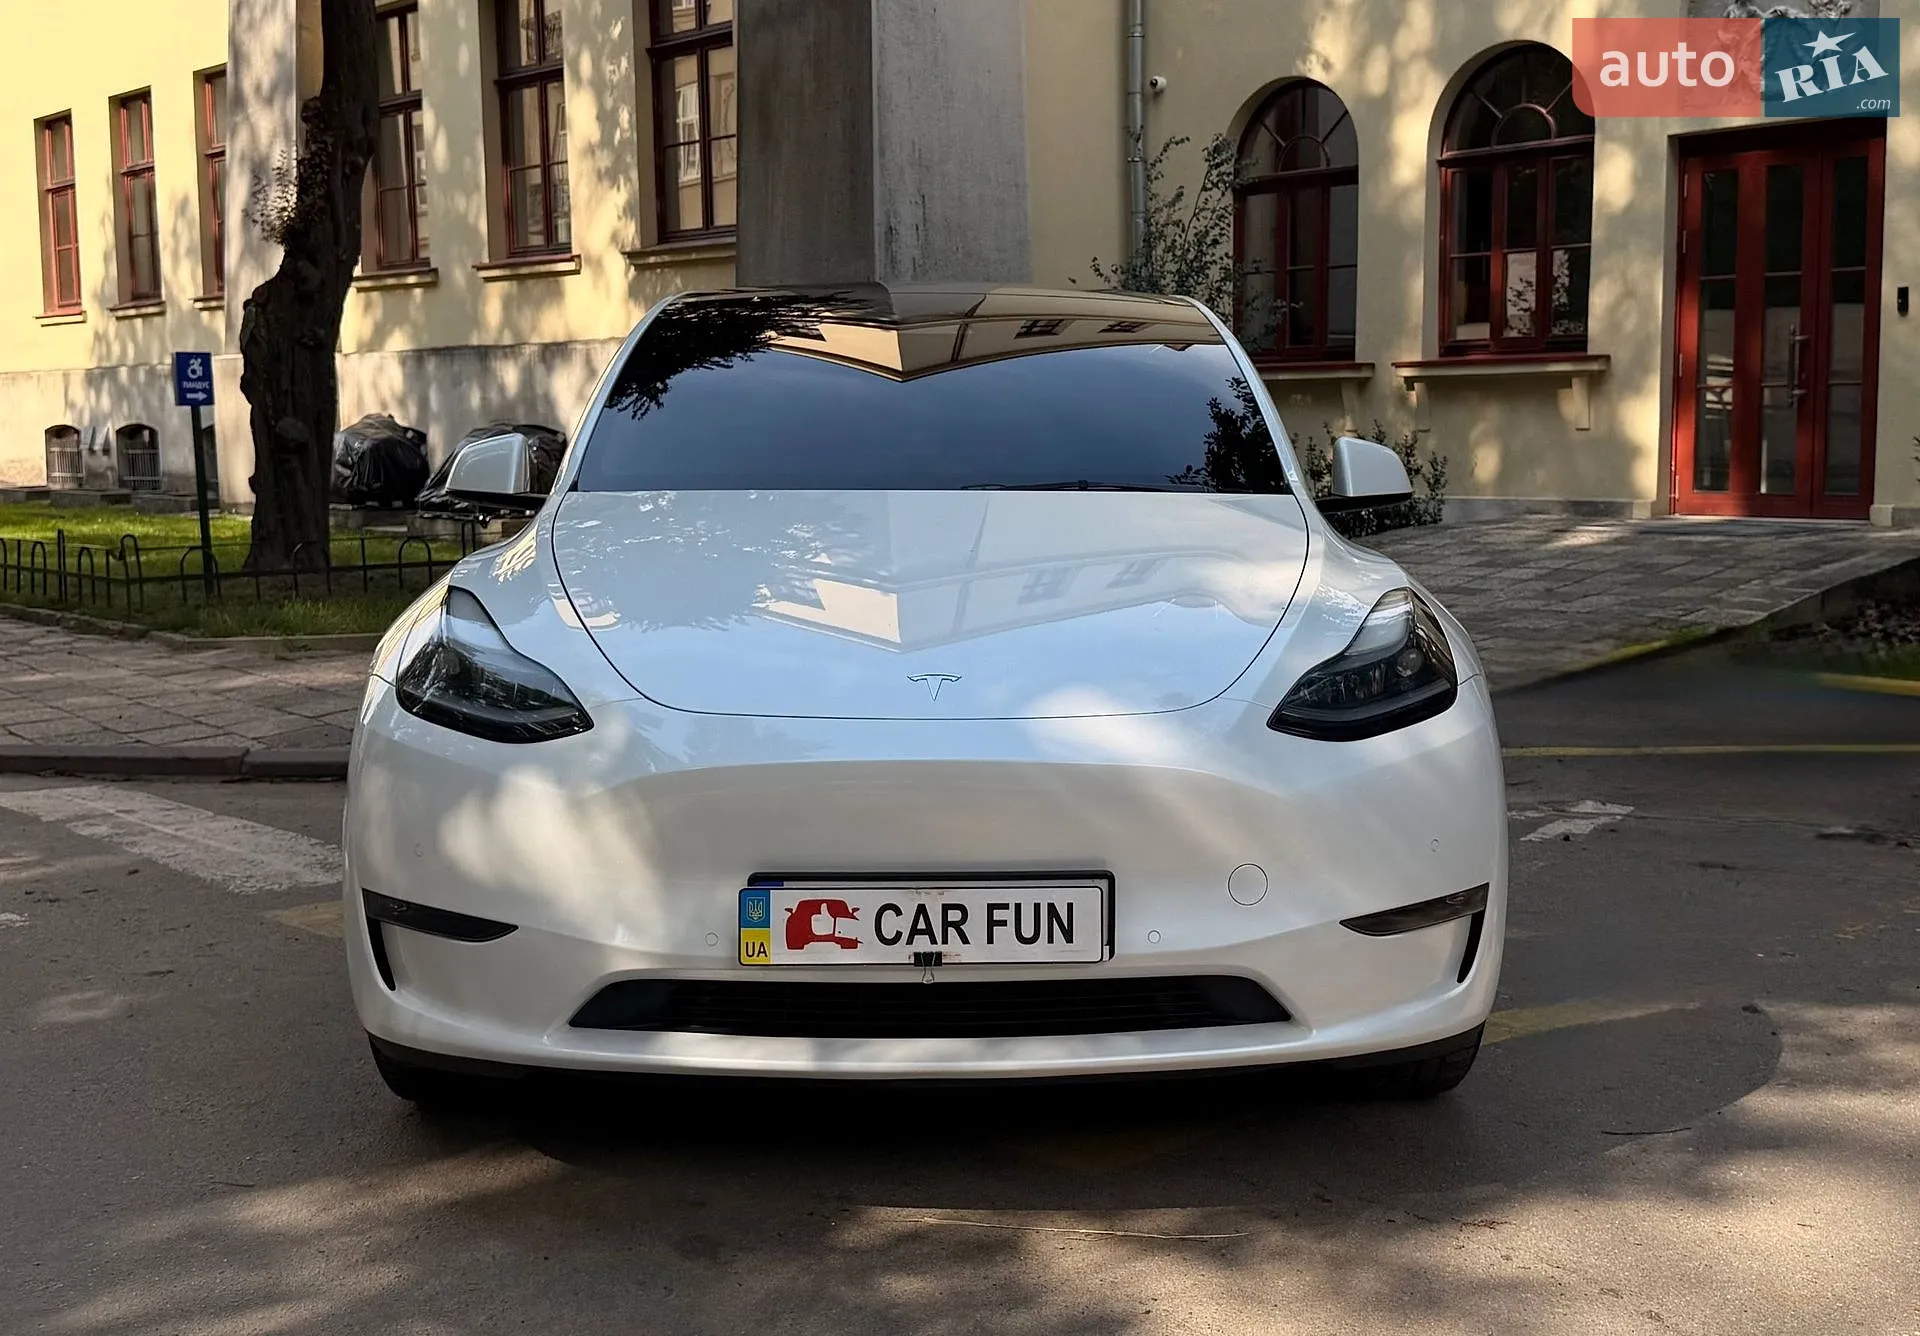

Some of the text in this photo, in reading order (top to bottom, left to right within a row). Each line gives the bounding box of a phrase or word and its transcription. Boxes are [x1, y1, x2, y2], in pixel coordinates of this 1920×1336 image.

[874, 901, 1074, 946] CAR FUN
[745, 941, 769, 958] UA
